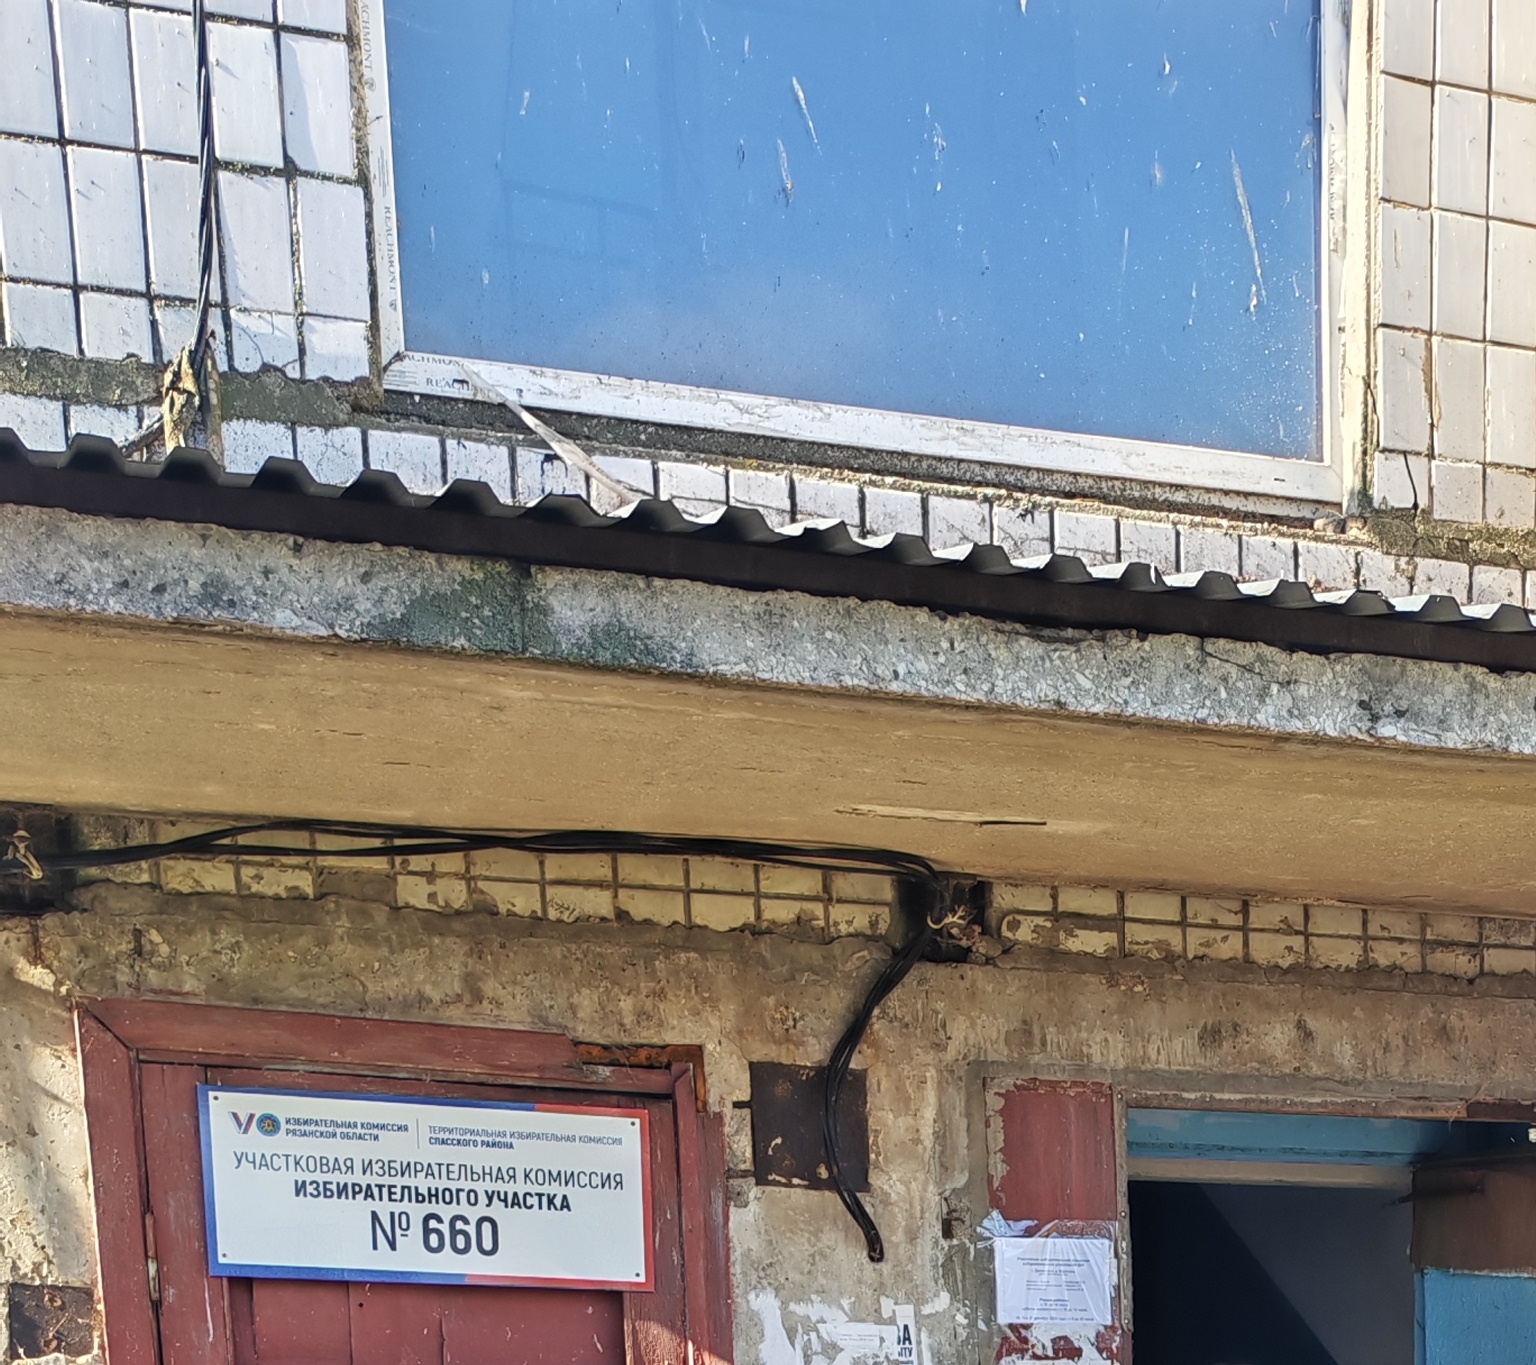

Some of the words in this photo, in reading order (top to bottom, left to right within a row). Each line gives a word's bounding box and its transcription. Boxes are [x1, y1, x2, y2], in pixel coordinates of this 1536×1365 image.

[285, 1117, 358, 1131] ИЗБИРАТЕЛЬНАЯ
[360, 1122, 409, 1133] КОМИССИЯ
[285, 1128, 337, 1140] РЯЗАНСКОЙ
[339, 1131, 379, 1142] ОБЛАСТИ
[428, 1125, 507, 1139] ТЕРРИТОРИАЛЬНАЯ
[509, 1131, 577, 1144] ИЗБИРАТЕЛЬНАЯ
[578, 1135, 623, 1146] КОМИССИЯ
[429, 1137, 480, 1148] СПАССКОГО
[481, 1138, 514, 1150] РАЙОНА
[233, 1150, 354, 1175] УЧАСТКОВАЯ
[362, 1158, 516, 1184] ИЗБИРАТЕЛЬНАЯ
[524, 1167, 624, 1191] КОМИССИЯ
[294, 1180, 479, 1206] ИЗБИРАТЕЛЬНОГО
[485, 1189, 571, 1212] УЧАСТКА
[370, 1210, 410, 1251] №
[422, 1213, 499, 1256] 660
